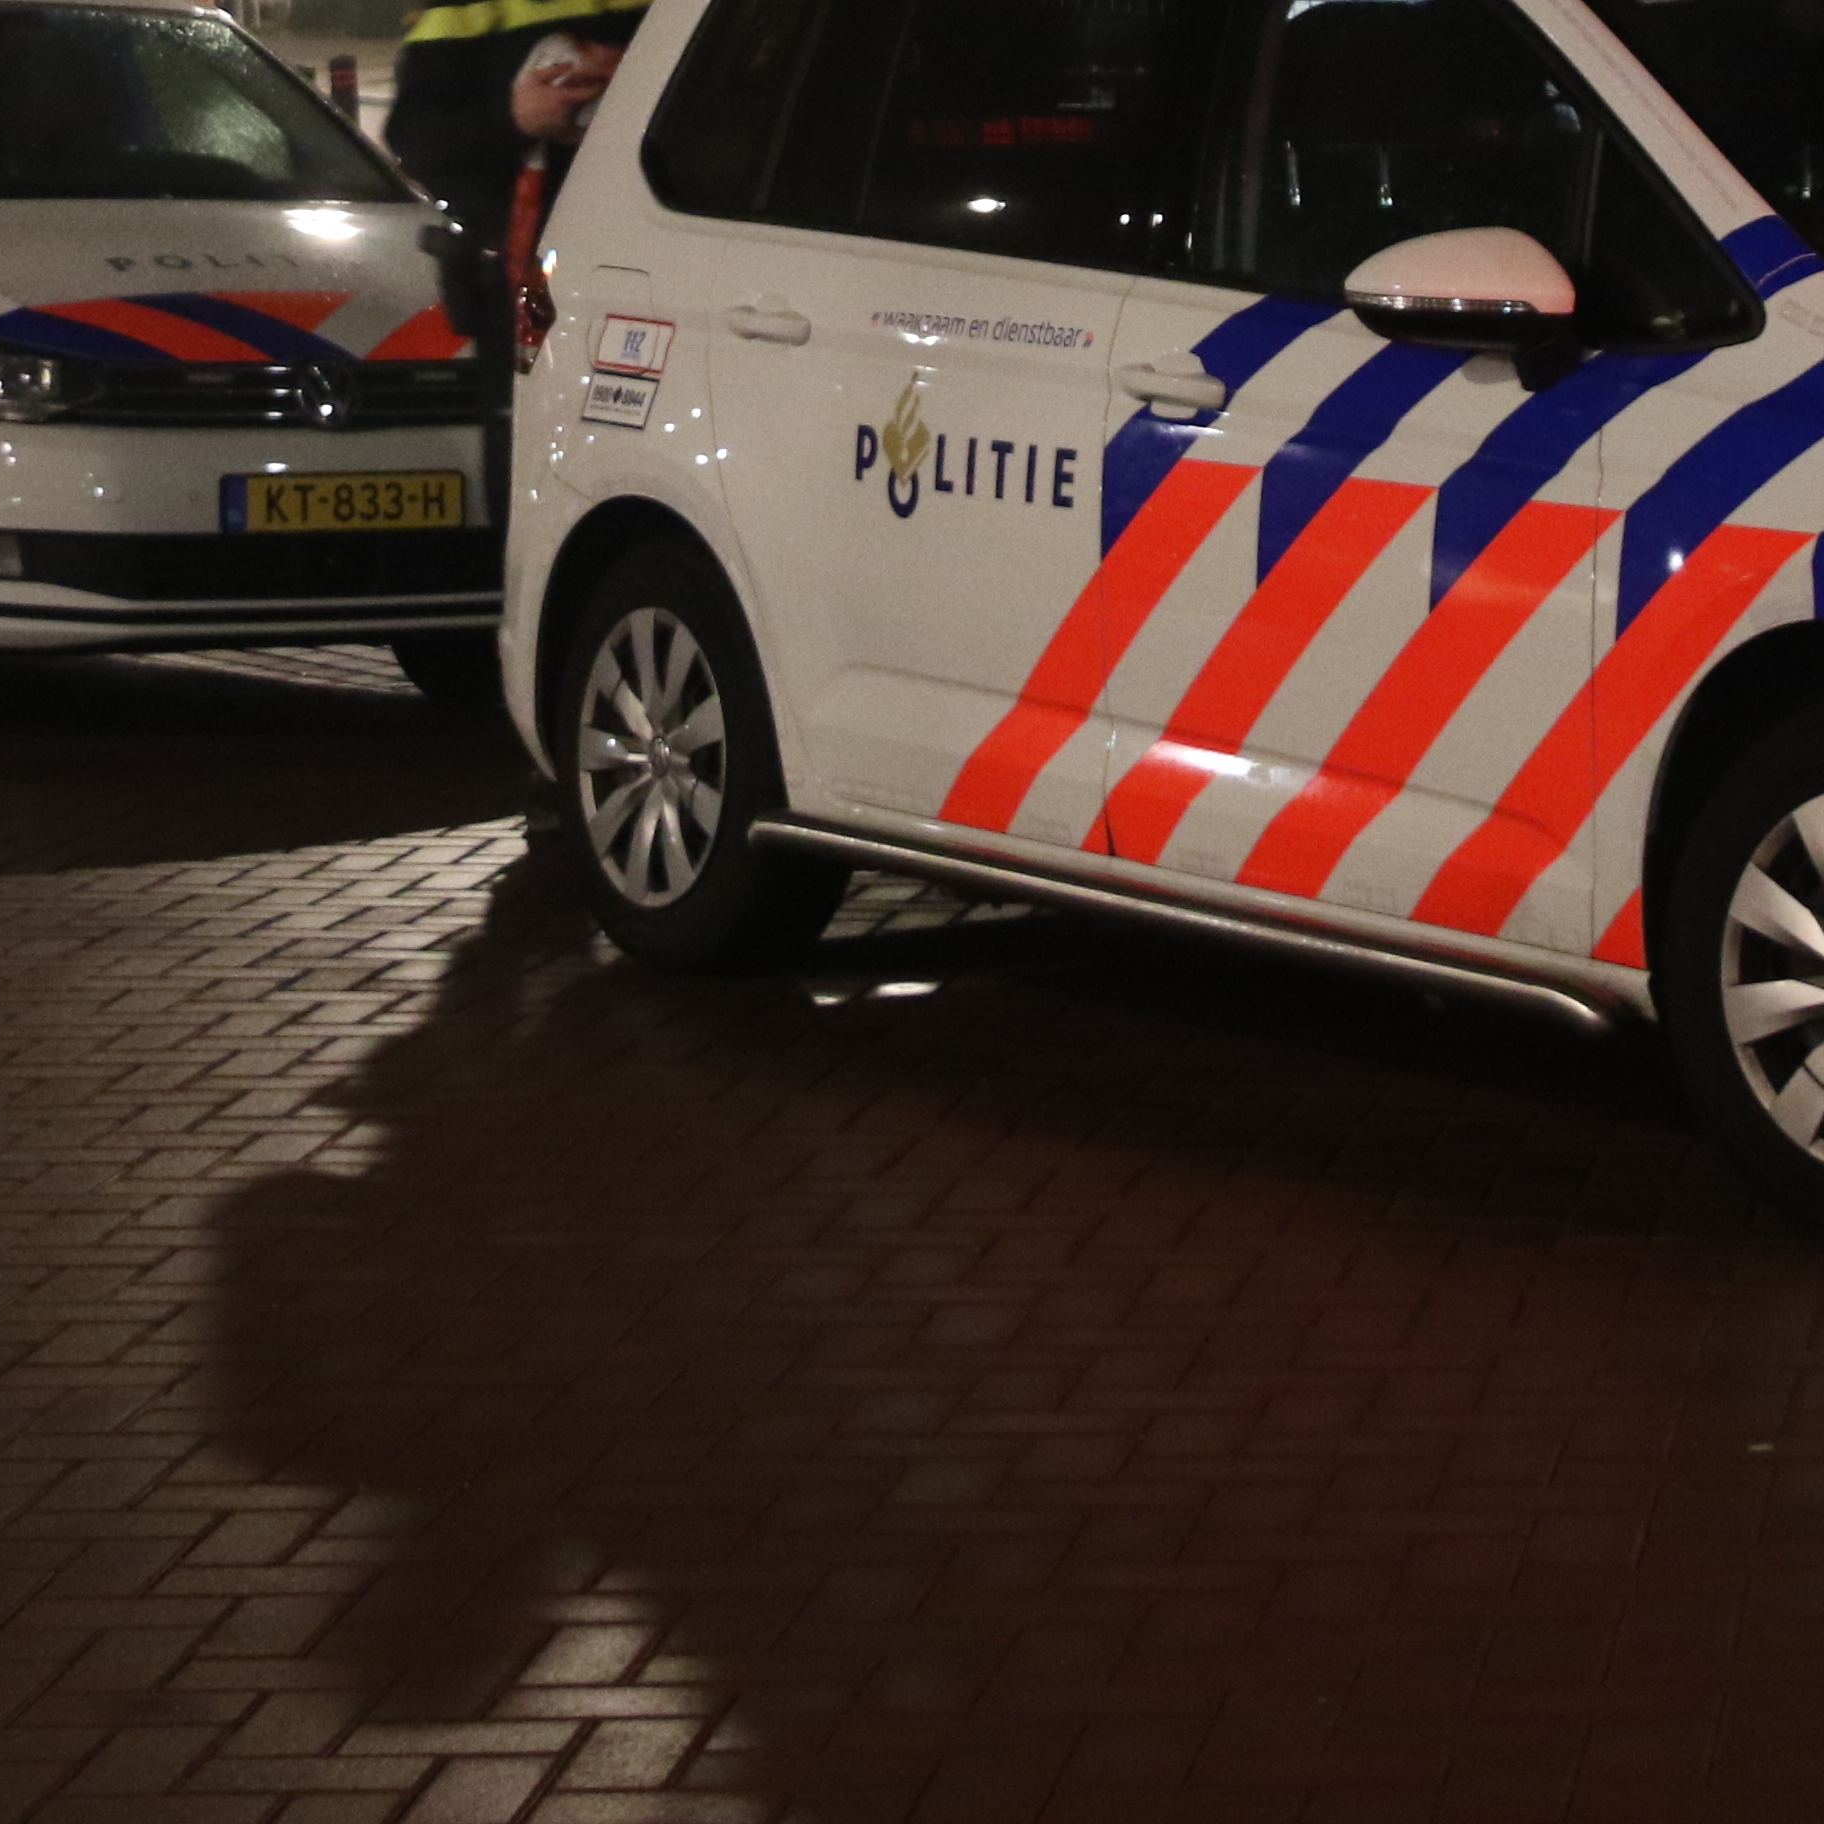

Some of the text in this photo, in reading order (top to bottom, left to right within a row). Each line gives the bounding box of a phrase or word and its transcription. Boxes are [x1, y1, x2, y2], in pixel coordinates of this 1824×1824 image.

[969, 317, 991, 339] en
[993, 317, 1083, 348] dienstbaar
[855, 424, 1078, 518] POLITIE
[264, 481, 447, 524] KT-833-H
